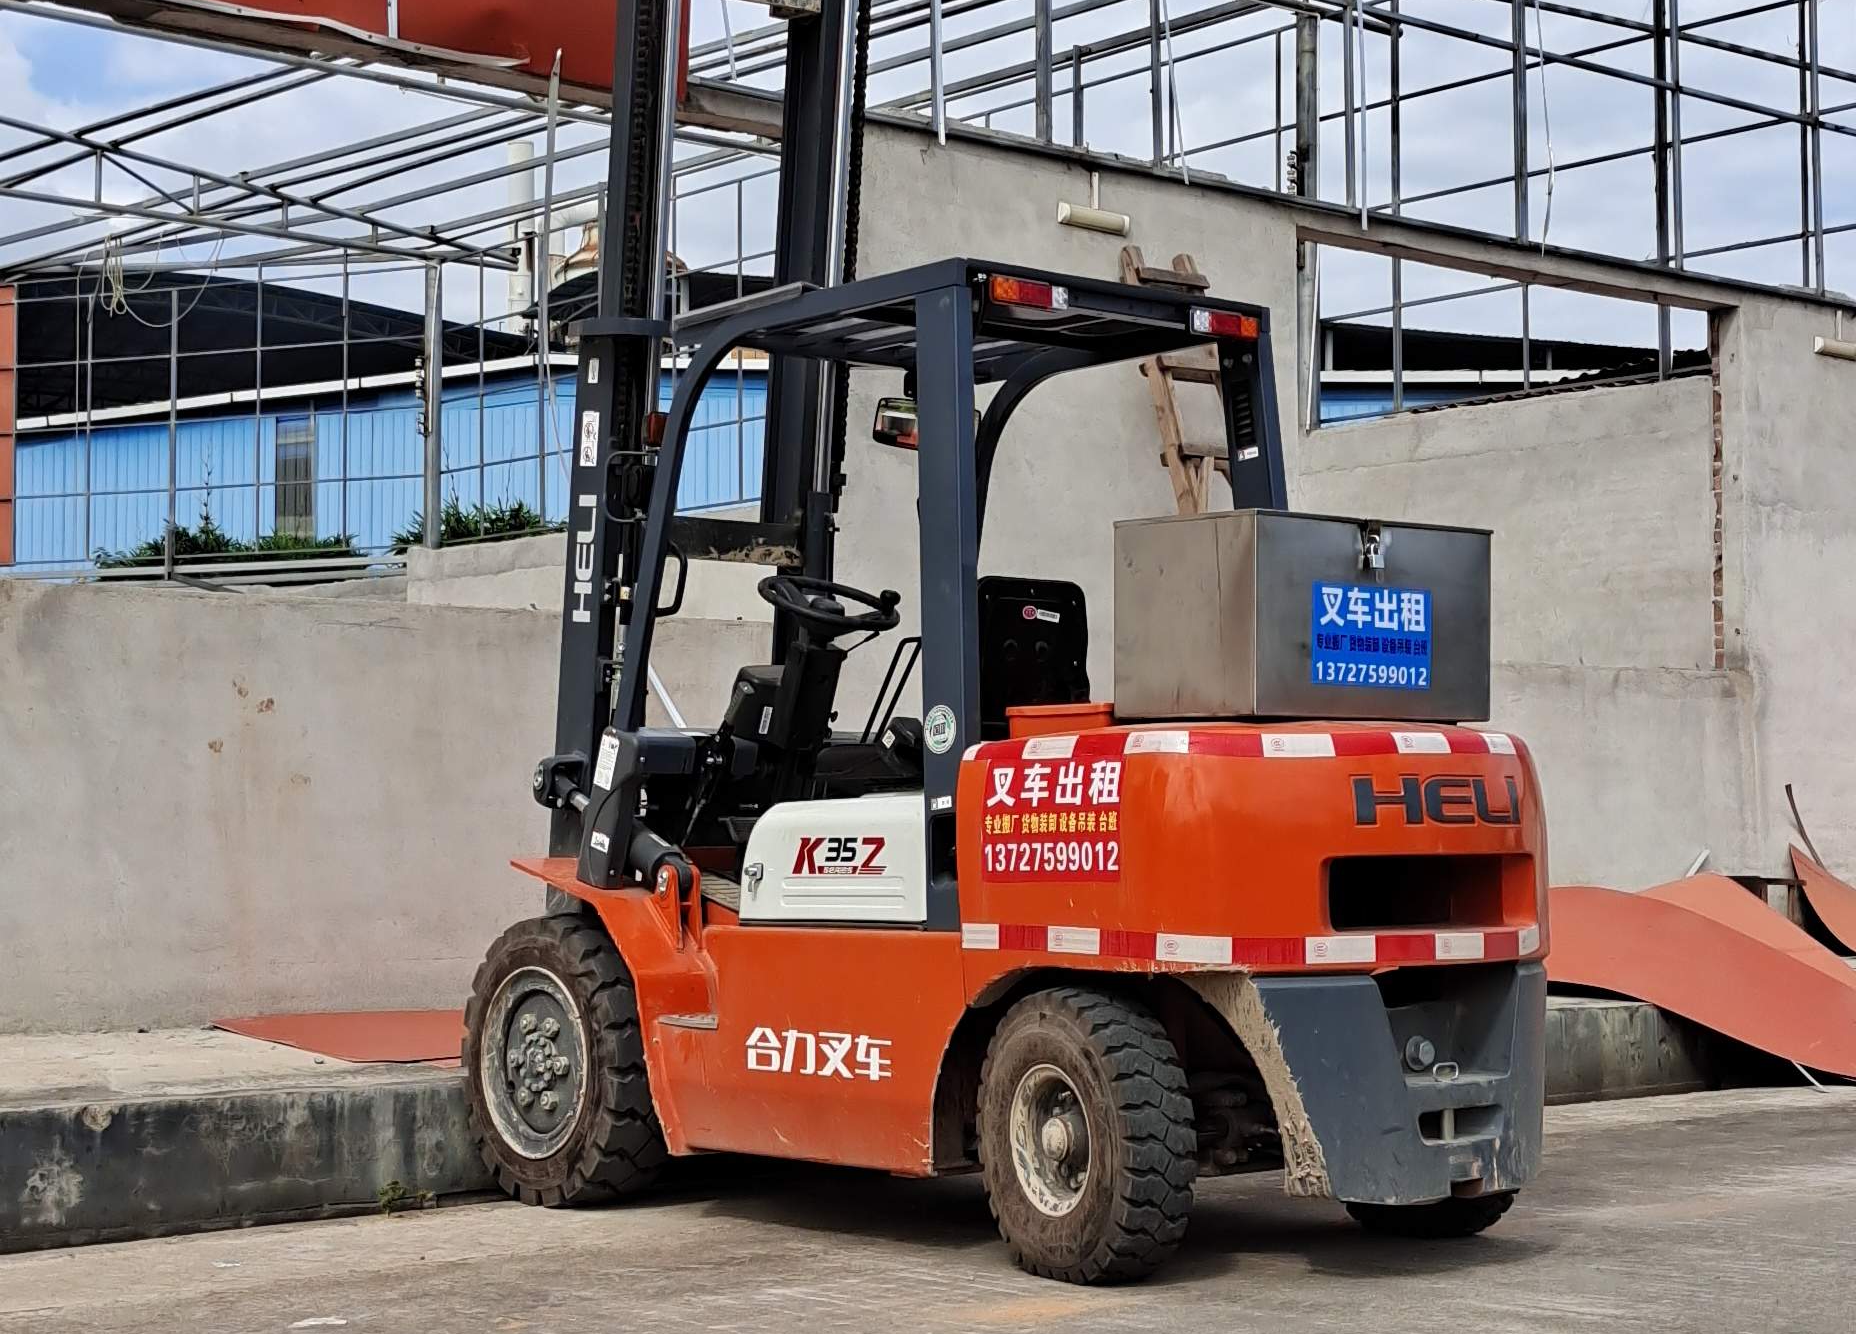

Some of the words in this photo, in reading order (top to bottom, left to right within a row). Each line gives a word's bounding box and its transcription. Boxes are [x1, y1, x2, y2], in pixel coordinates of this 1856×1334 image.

[1319, 586, 1426, 632] 叉车出租
[1315, 660, 1427, 686] 13727599012
[986, 759, 1122, 808] 叉车出租
[1021, 812, 1057, 834] 货物装卸
[1059, 811, 1096, 833] 设备吊装
[984, 840, 1119, 872] 13727599012
[745, 1026, 892, 1081] 合力叉车
